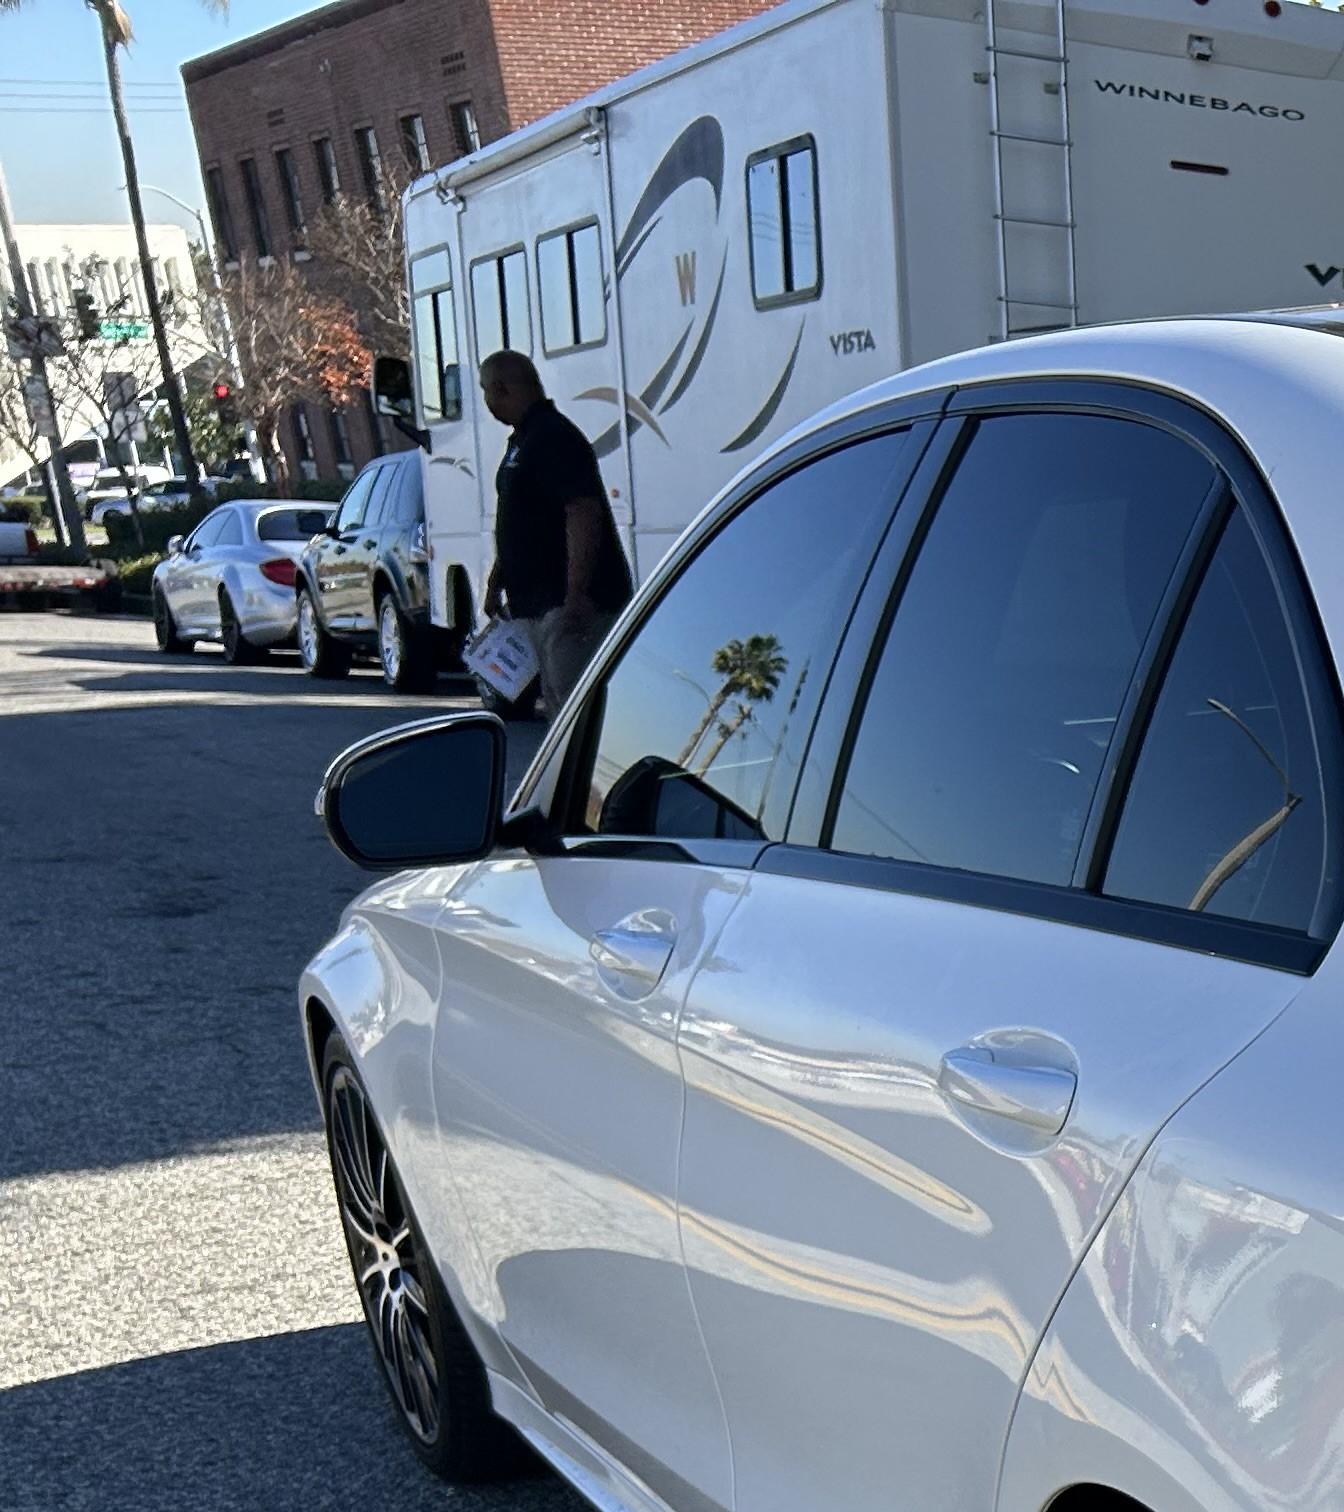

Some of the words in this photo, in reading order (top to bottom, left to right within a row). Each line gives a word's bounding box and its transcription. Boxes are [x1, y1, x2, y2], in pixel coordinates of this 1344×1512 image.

[1095, 79, 1305, 121] WINNEBAGO
[675, 251, 697, 306] W
[829, 328, 876, 356] VISTA
